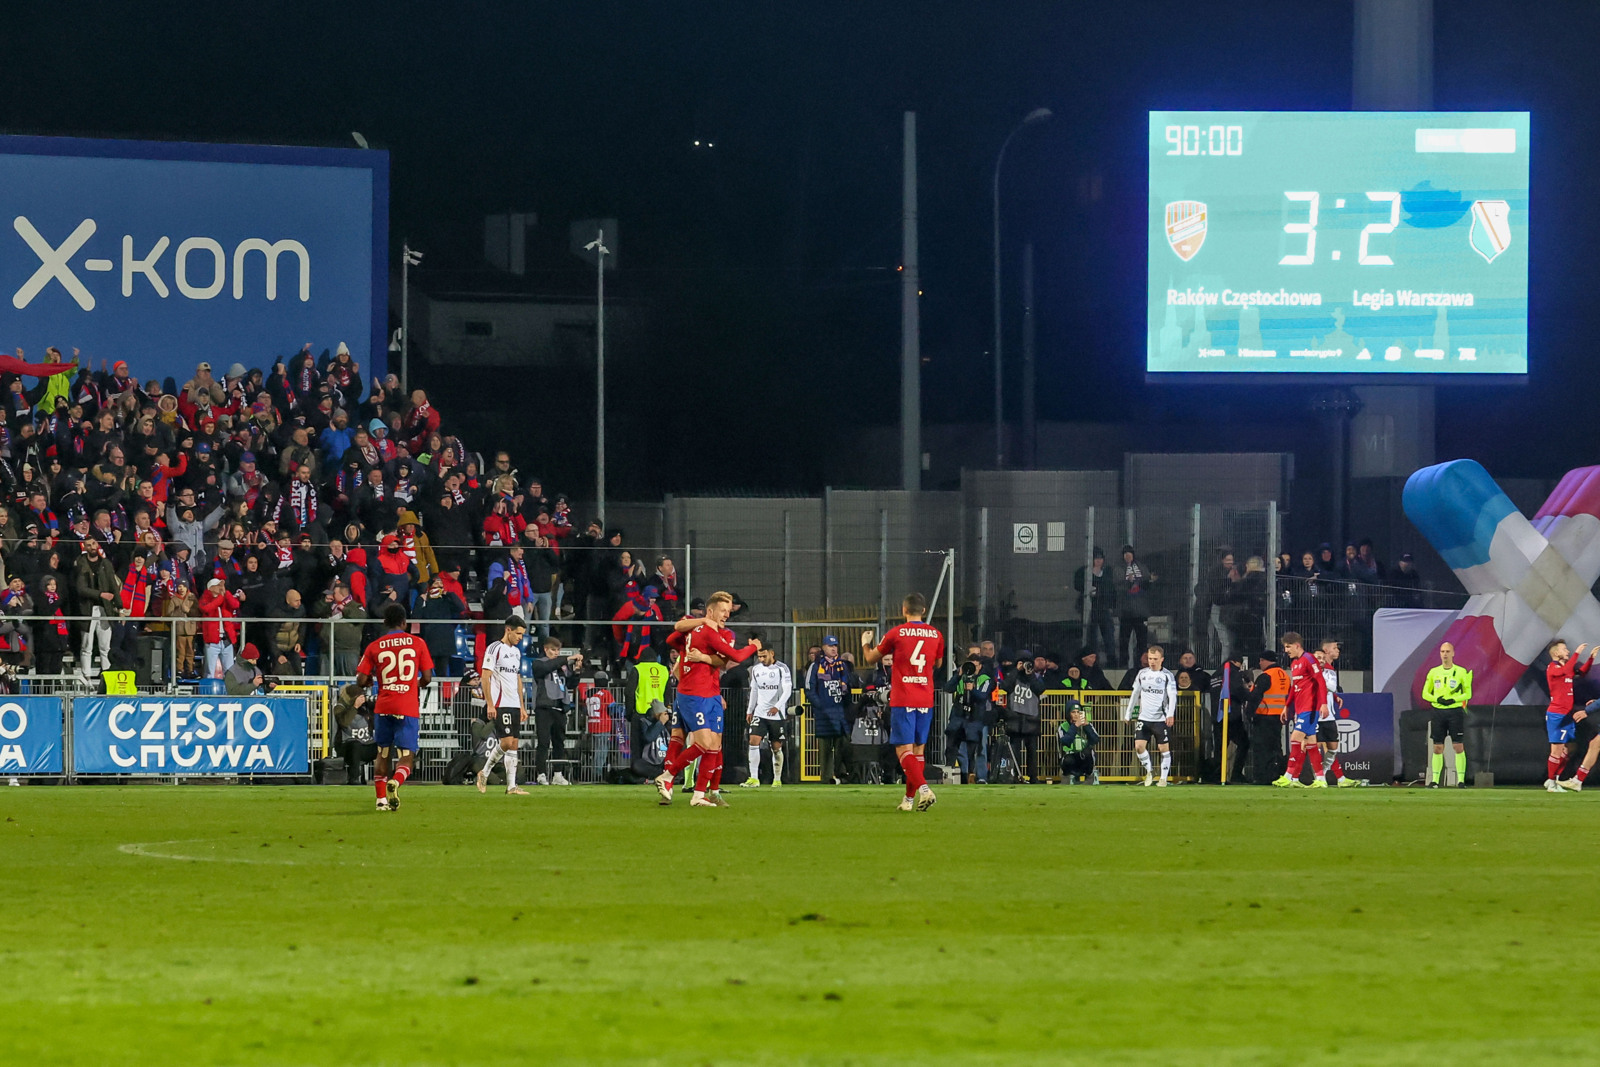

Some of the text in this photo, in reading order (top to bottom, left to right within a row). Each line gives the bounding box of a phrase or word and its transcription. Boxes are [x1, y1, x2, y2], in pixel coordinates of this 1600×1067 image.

[1165, 125, 1243, 156] 90:00
[1278, 191, 1401, 265] 3:2
[1167, 287, 1322, 309] Raków Częstochowa
[1353, 290, 1474, 310] Legia Warszawa
[379, 637, 413, 649] OTIENO
[899, 627, 938, 639] SVARNAS
[377, 648, 416, 685] 26
[909, 640, 926, 673] 4
[108, 703, 274, 746] CZĘSTO
[502, 713, 512, 725] 61
[695, 712, 705, 726] 3
[1560, 730, 1568, 741] 7
[1344, 761, 1371, 771] Polski
